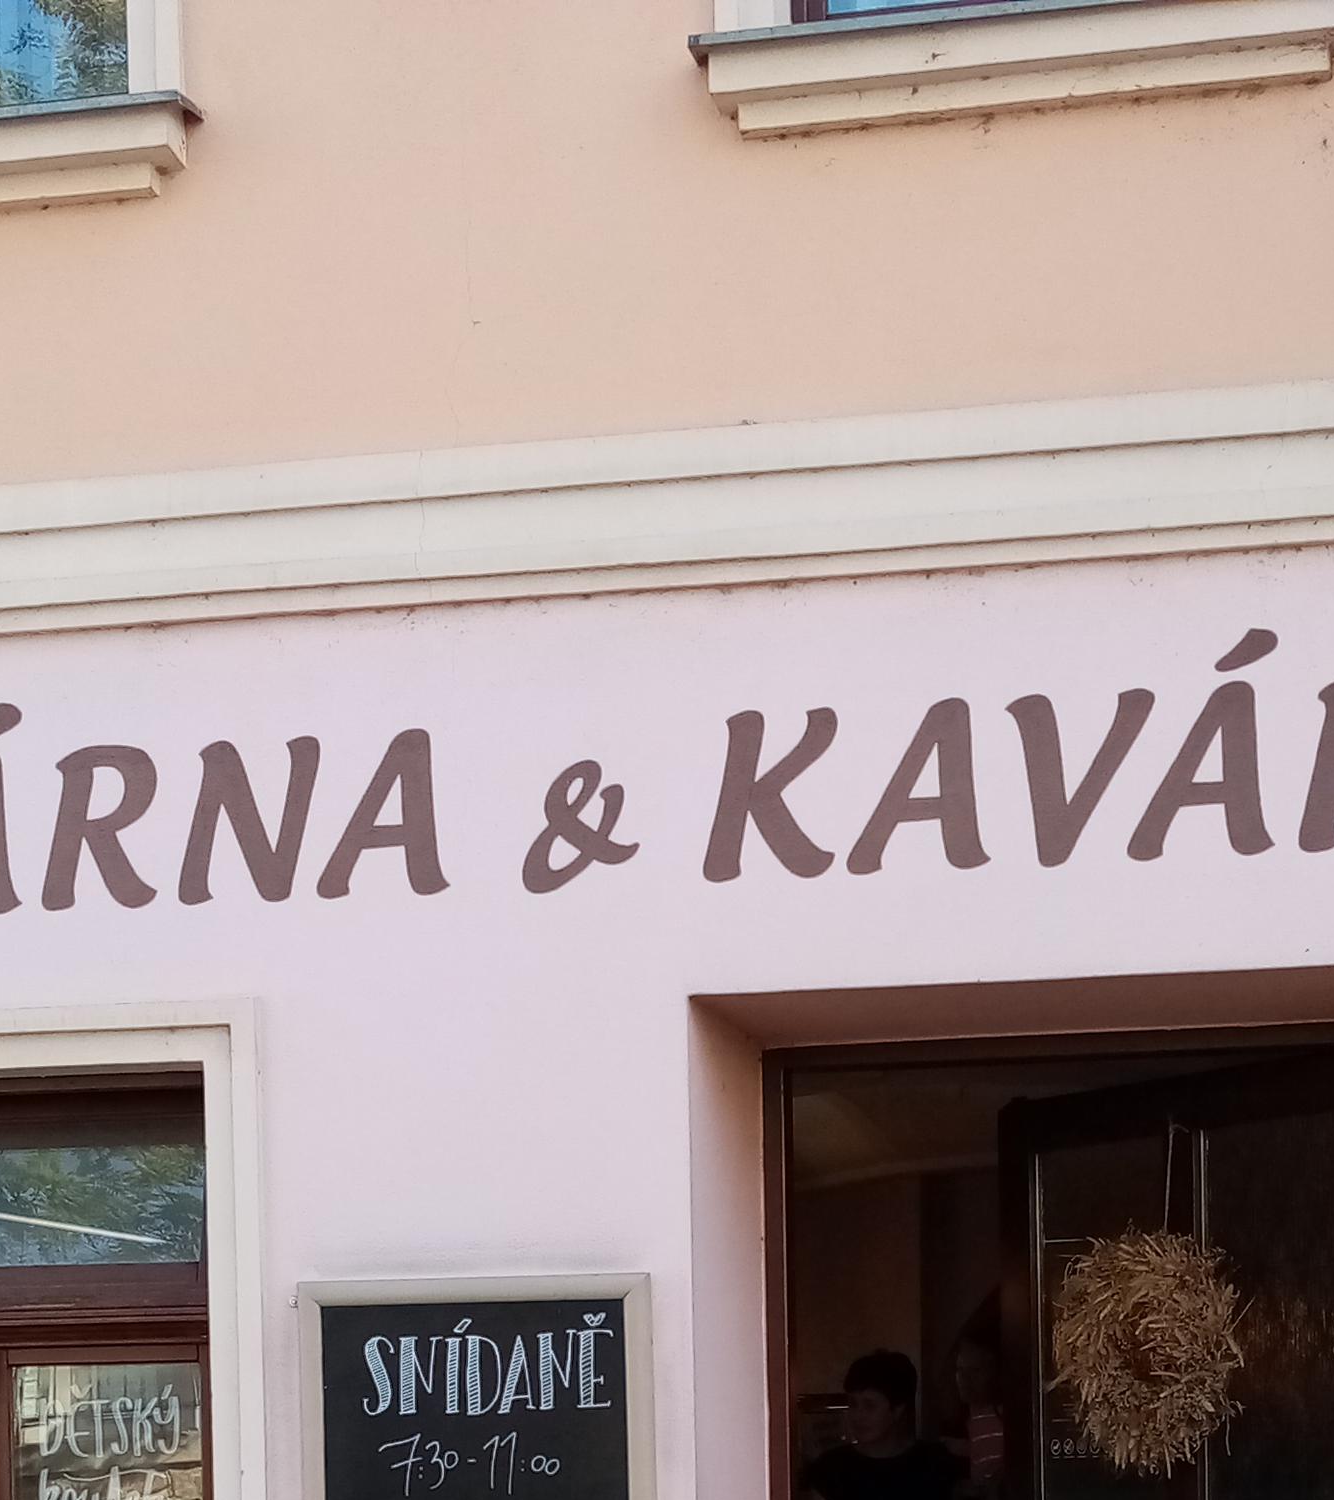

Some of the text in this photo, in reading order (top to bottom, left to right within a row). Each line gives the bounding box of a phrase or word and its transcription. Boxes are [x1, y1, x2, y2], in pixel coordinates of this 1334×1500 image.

[521, 759, 639, 893] &
[363, 1312, 613, 1416] SNÍDANĚ
[39, 1384, 180, 1458] DĚTSKÝ
